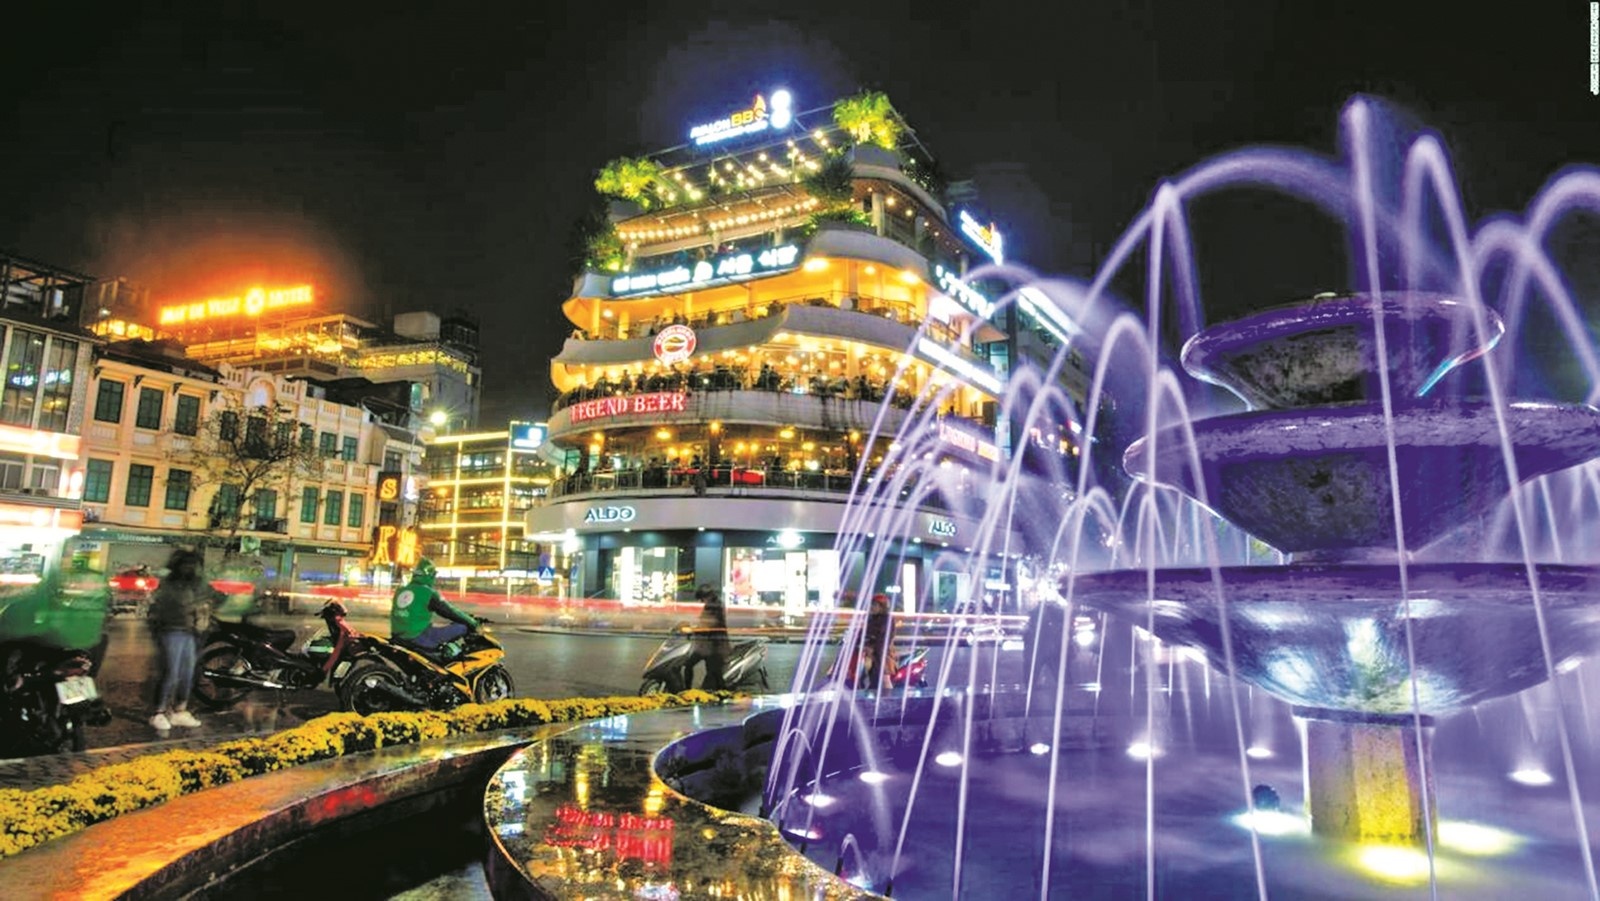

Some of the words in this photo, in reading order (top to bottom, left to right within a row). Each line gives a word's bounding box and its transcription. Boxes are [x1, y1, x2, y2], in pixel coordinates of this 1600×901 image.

[571, 397, 627, 424] LEGEND
[634, 392, 685, 412] BEER
[585, 506, 635, 523] ALDO
